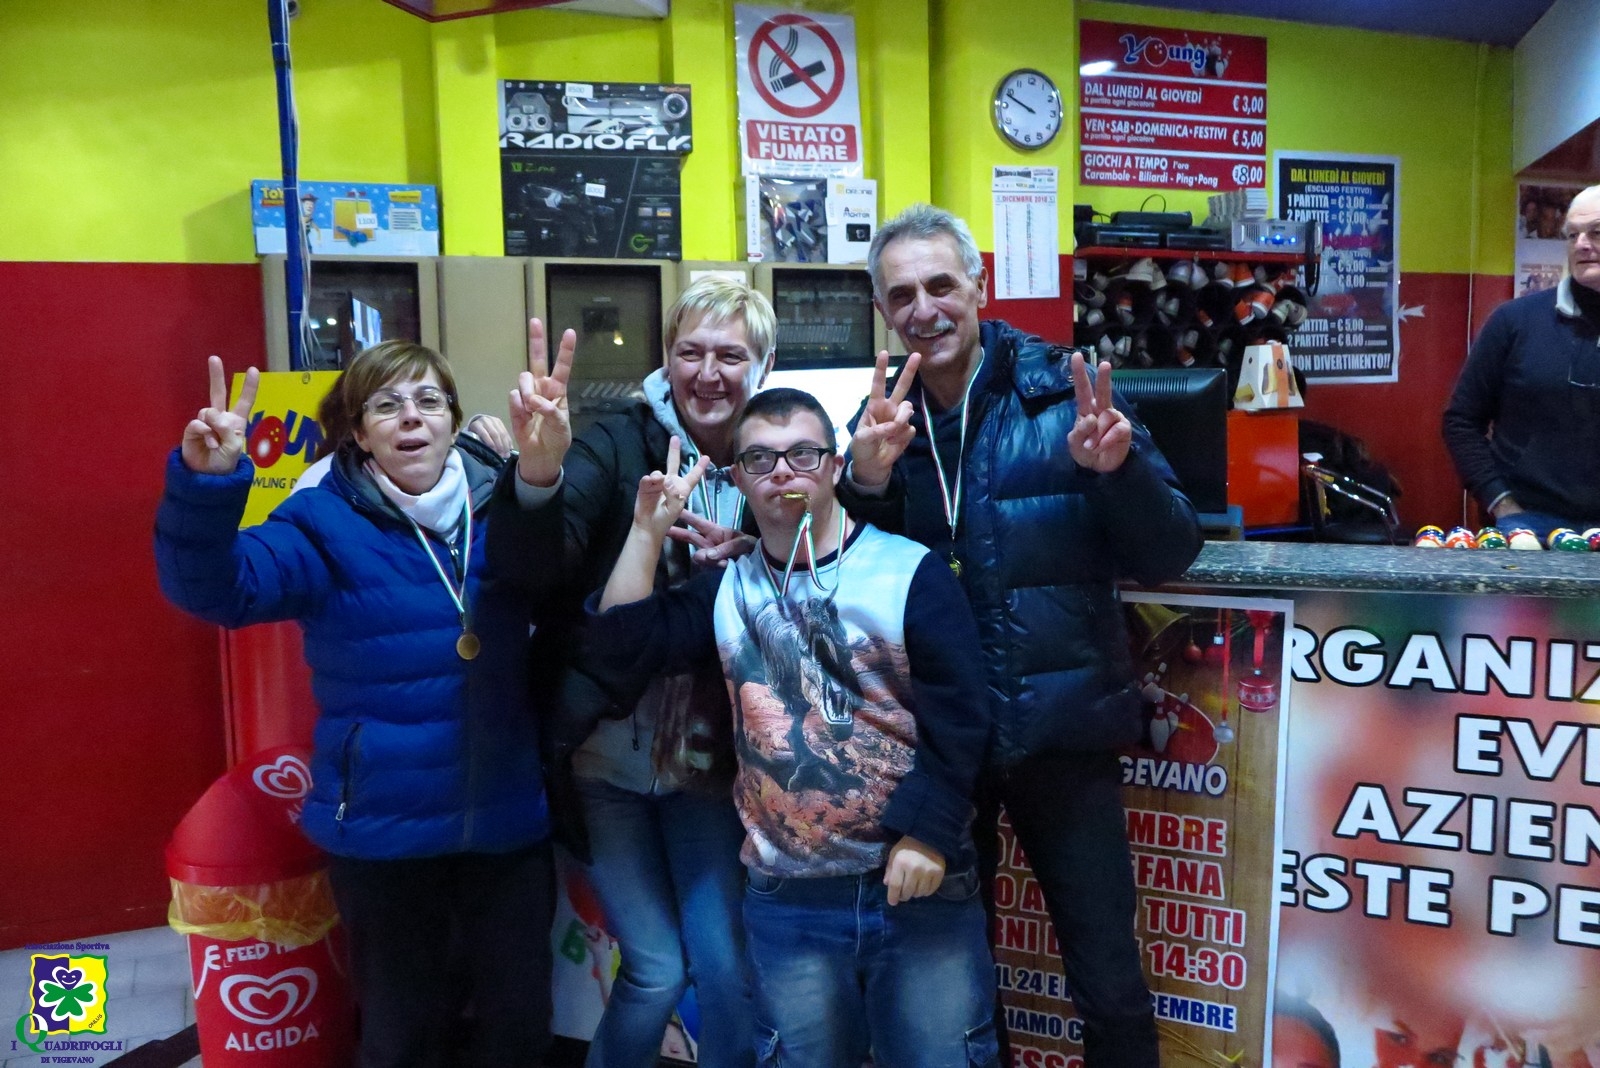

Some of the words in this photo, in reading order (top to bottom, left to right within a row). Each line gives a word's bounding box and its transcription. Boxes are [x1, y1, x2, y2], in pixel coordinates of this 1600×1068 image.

[1084, 82, 1104, 96] DAL
[1107, 83, 1144, 97] LUNEDÌ
[1146, 89, 1158, 100] AL
[1160, 88, 1202, 104] GIOVEDÌ
[1232, 95, 1240, 112] €
[1242, 96, 1264, 115] 3,00
[755, 123, 846, 142] VIETATO
[1232, 129, 1239, 146] €
[1241, 131, 1263, 149] 5,00
[759, 141, 848, 161] FUMARE
[1084, 154, 1122, 168] GIOCHI
[1124, 156, 1132, 168] A
[1134, 156, 1168, 170] TEMPO
[1084, 168, 1130, 181] Carambole
[1138, 171, 1168, 183] Biliardi
[1291, 168, 1308, 182] DAL
[1309, 168, 1339, 183] LUNEDÌ
[1340, 170, 1350, 184] AL
[1352, 170, 1386, 186] GIOVEDÌ
[1305, 184, 1340, 194] (ESCLUSO
[1287, 194, 1292, 207] 1
[1293, 193, 1329, 208] PARTITA
[1338, 195, 1344, 208] €
[1294, 209, 1329, 223] PARTITE
[1338, 210, 1344, 224] €
[1337, 319, 1343, 332] €
[1294, 334, 1329, 347] PARTITE
[1337, 334, 1343, 347] €
[1314, 353, 1391, 370] DIVERTIMENTO!!
[252, 477, 287, 489] WLING
[1118, 755, 1228, 796] GEVANO
[1126, 809, 1226, 856] MBRE
[1132, 852, 1224, 898] FANA
[1144, 897, 1245, 946] TUTTI
[1488, 876, 1600, 948] PE
[226, 943, 270, 962] FEED
[1148, 941, 1246, 989] 14:30
[1016, 969, 1043, 994] 24
[1048, 975, 1059, 998] E
[1004, 1007, 1063, 1039] IAMO
[1067, 1020, 1084, 1044] C
[224, 1021, 320, 1052] ALGIDA
